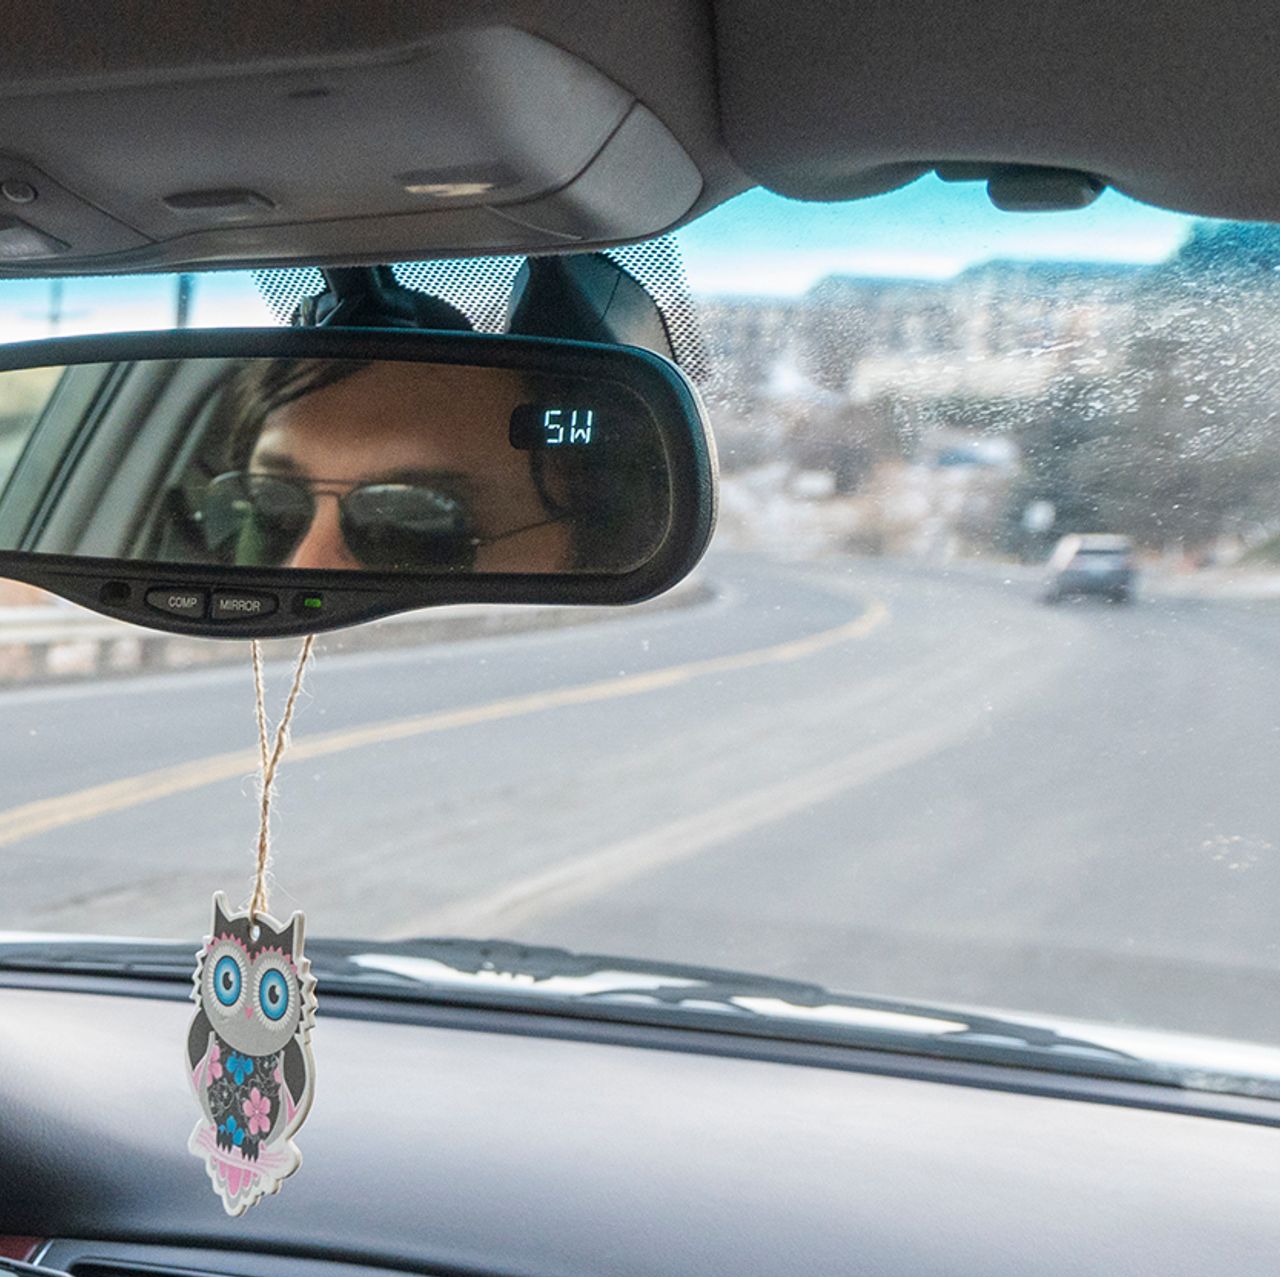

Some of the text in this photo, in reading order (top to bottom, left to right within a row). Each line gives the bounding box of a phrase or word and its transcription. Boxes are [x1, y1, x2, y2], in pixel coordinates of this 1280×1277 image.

[544, 410, 593, 443] SW
[168, 596, 197, 608] COMP
[220, 599, 261, 612] MIRROR
